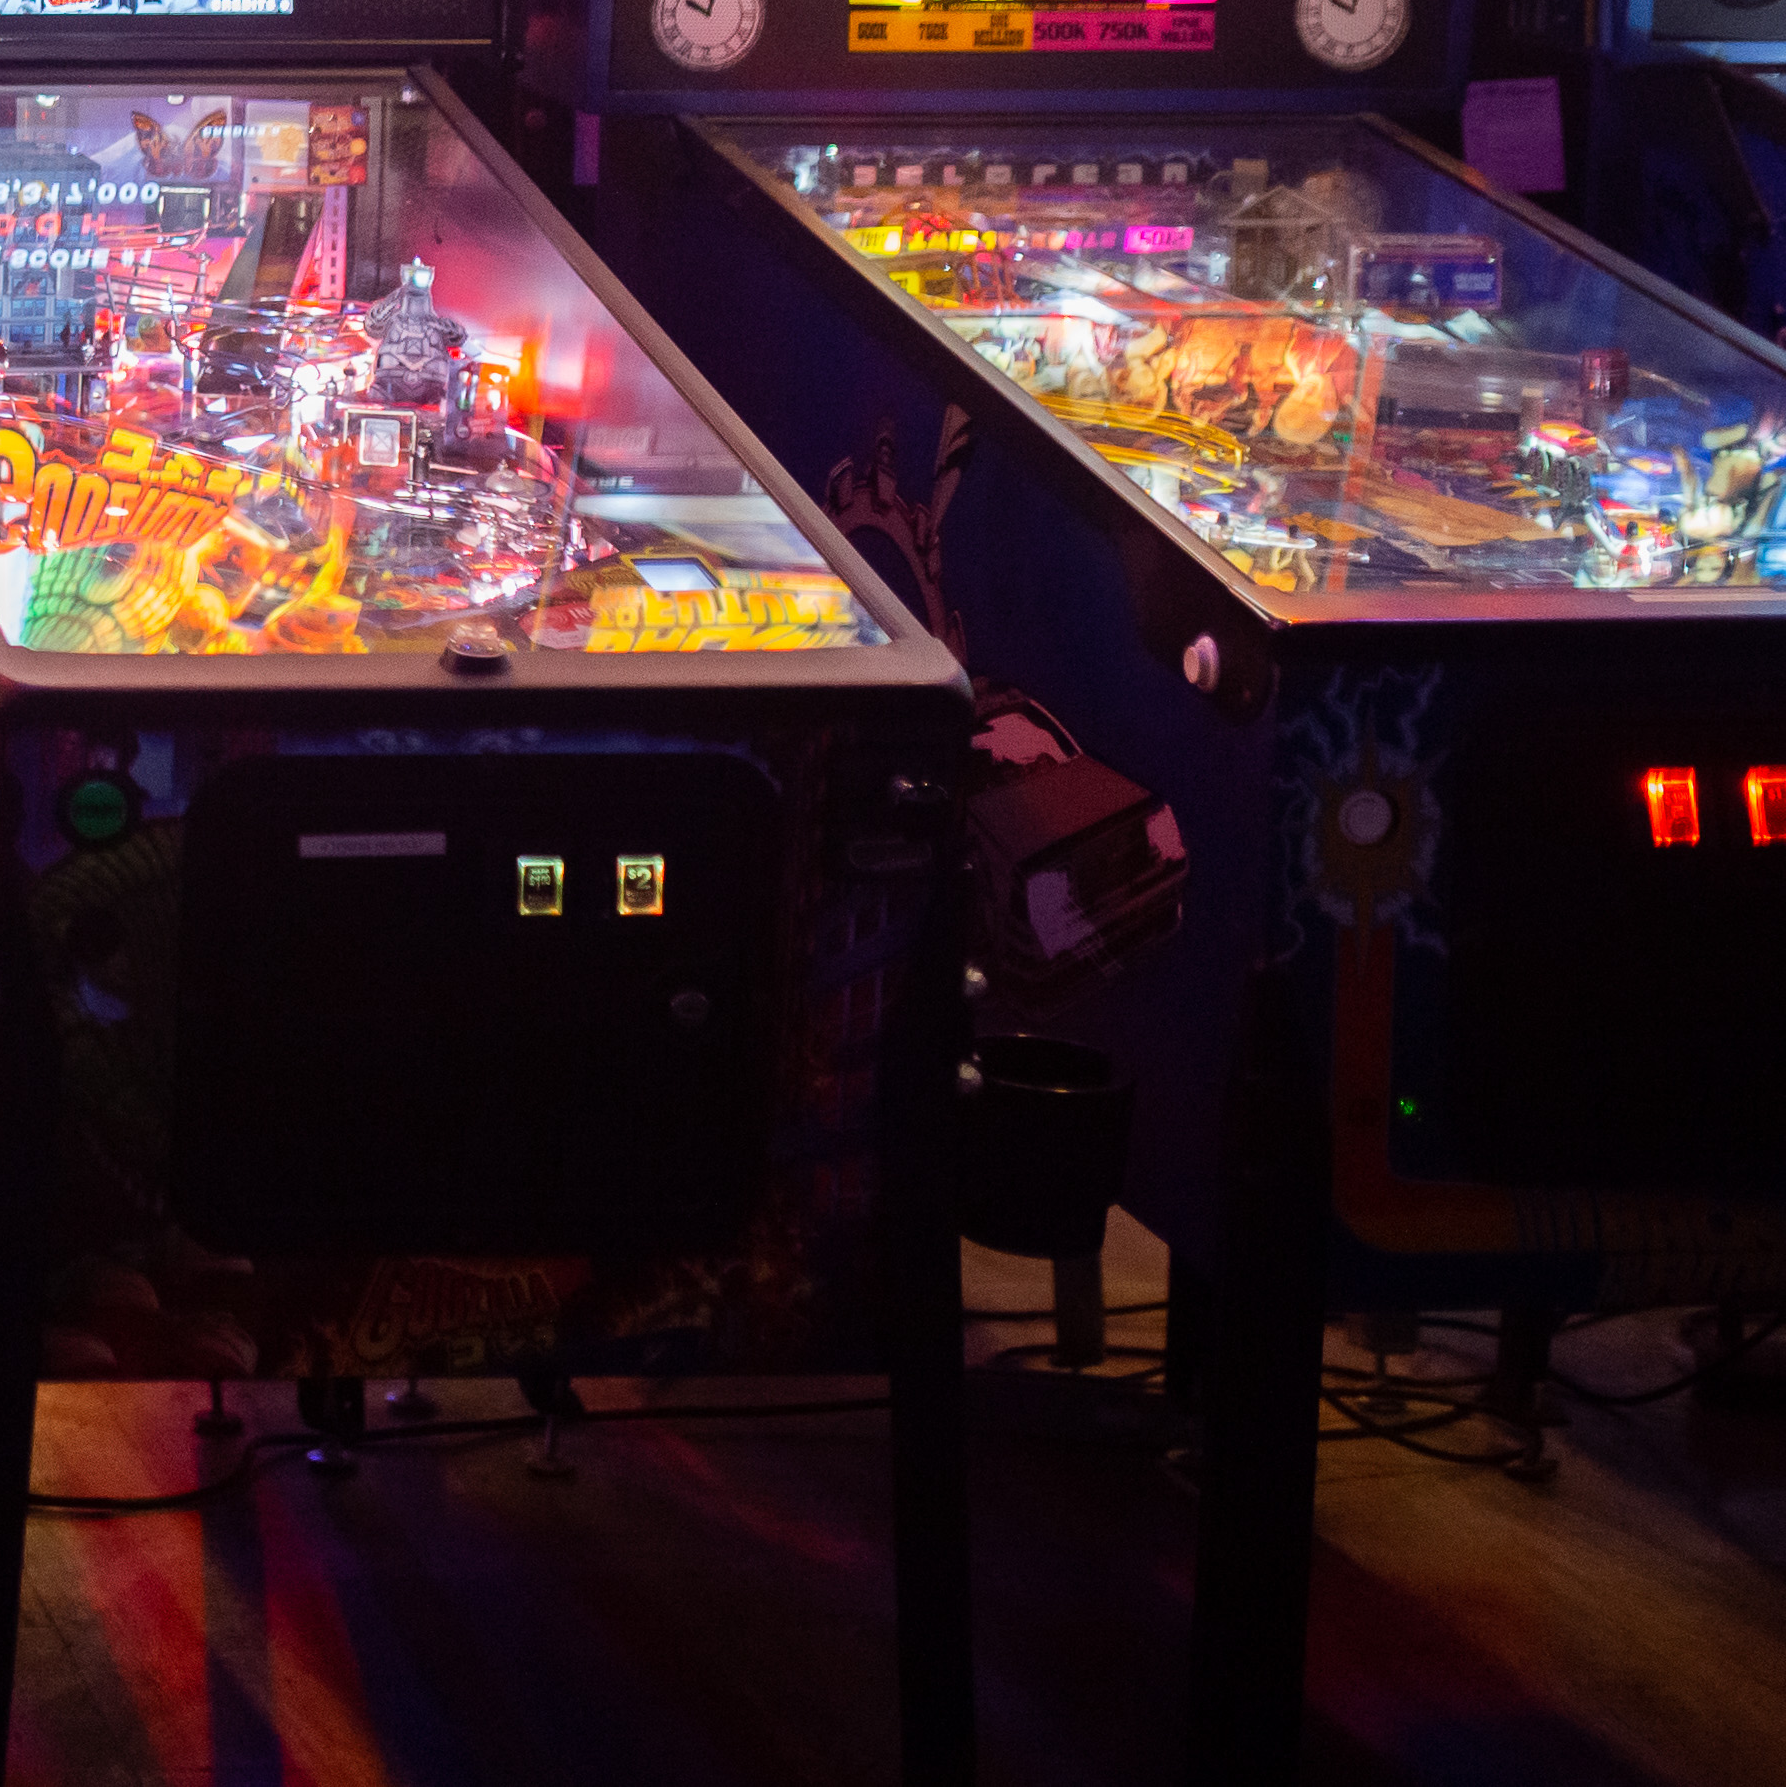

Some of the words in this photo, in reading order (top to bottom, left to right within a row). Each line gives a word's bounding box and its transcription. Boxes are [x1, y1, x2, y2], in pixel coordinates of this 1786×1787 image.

[1034, 22, 1085, 41] 500K
[1098, 22, 1149, 41] 750K
[626, 865, 654, 891] $2
